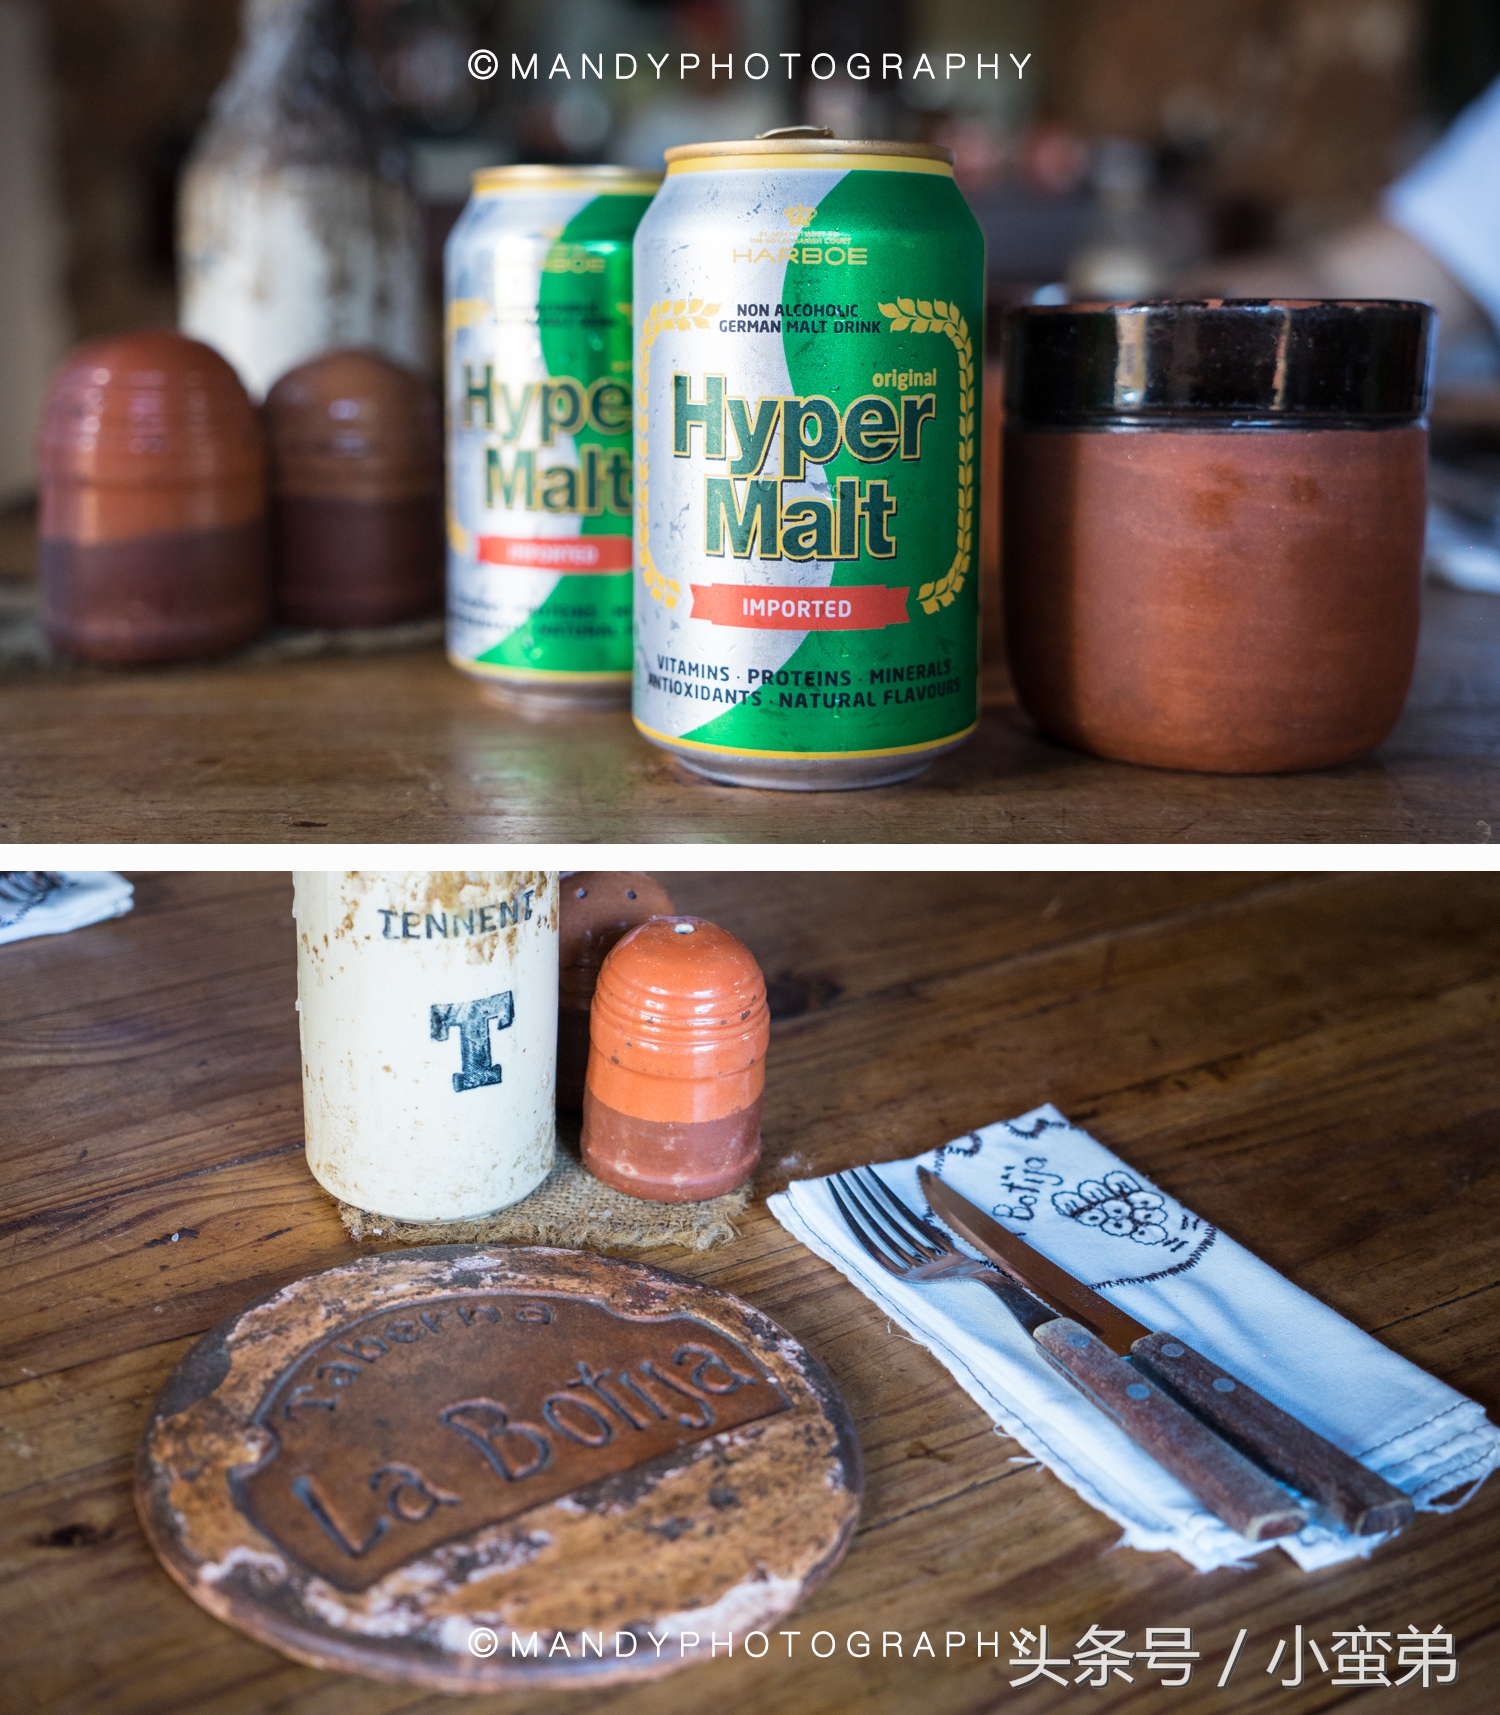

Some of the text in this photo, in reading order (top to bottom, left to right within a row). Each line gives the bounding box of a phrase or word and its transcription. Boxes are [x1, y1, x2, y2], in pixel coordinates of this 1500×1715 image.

[732, 246, 868, 266] HARBOE
[719, 320, 881, 334] GERMAN MALT DRINK
[737, 303, 859, 317] NON ALCOHOLIC
[872, 368, 937, 391] original
[670, 371, 937, 482] Hyper
[484, 443, 633, 517] Malt
[702, 473, 898, 562] Malt
[742, 597, 852, 619] IMPORTED
[647, 671, 961, 709] ANTIOXIDANTS NATURAL FLAVOURS
[656, 653, 951, 687] VITAMINS PROTEINS MINERALS
[377, 888, 536, 940] TENNENT
[430, 990, 515, 1093] T
[280, 1301, 557, 1421] Taberna
[291, 1462, 461, 1559] La
